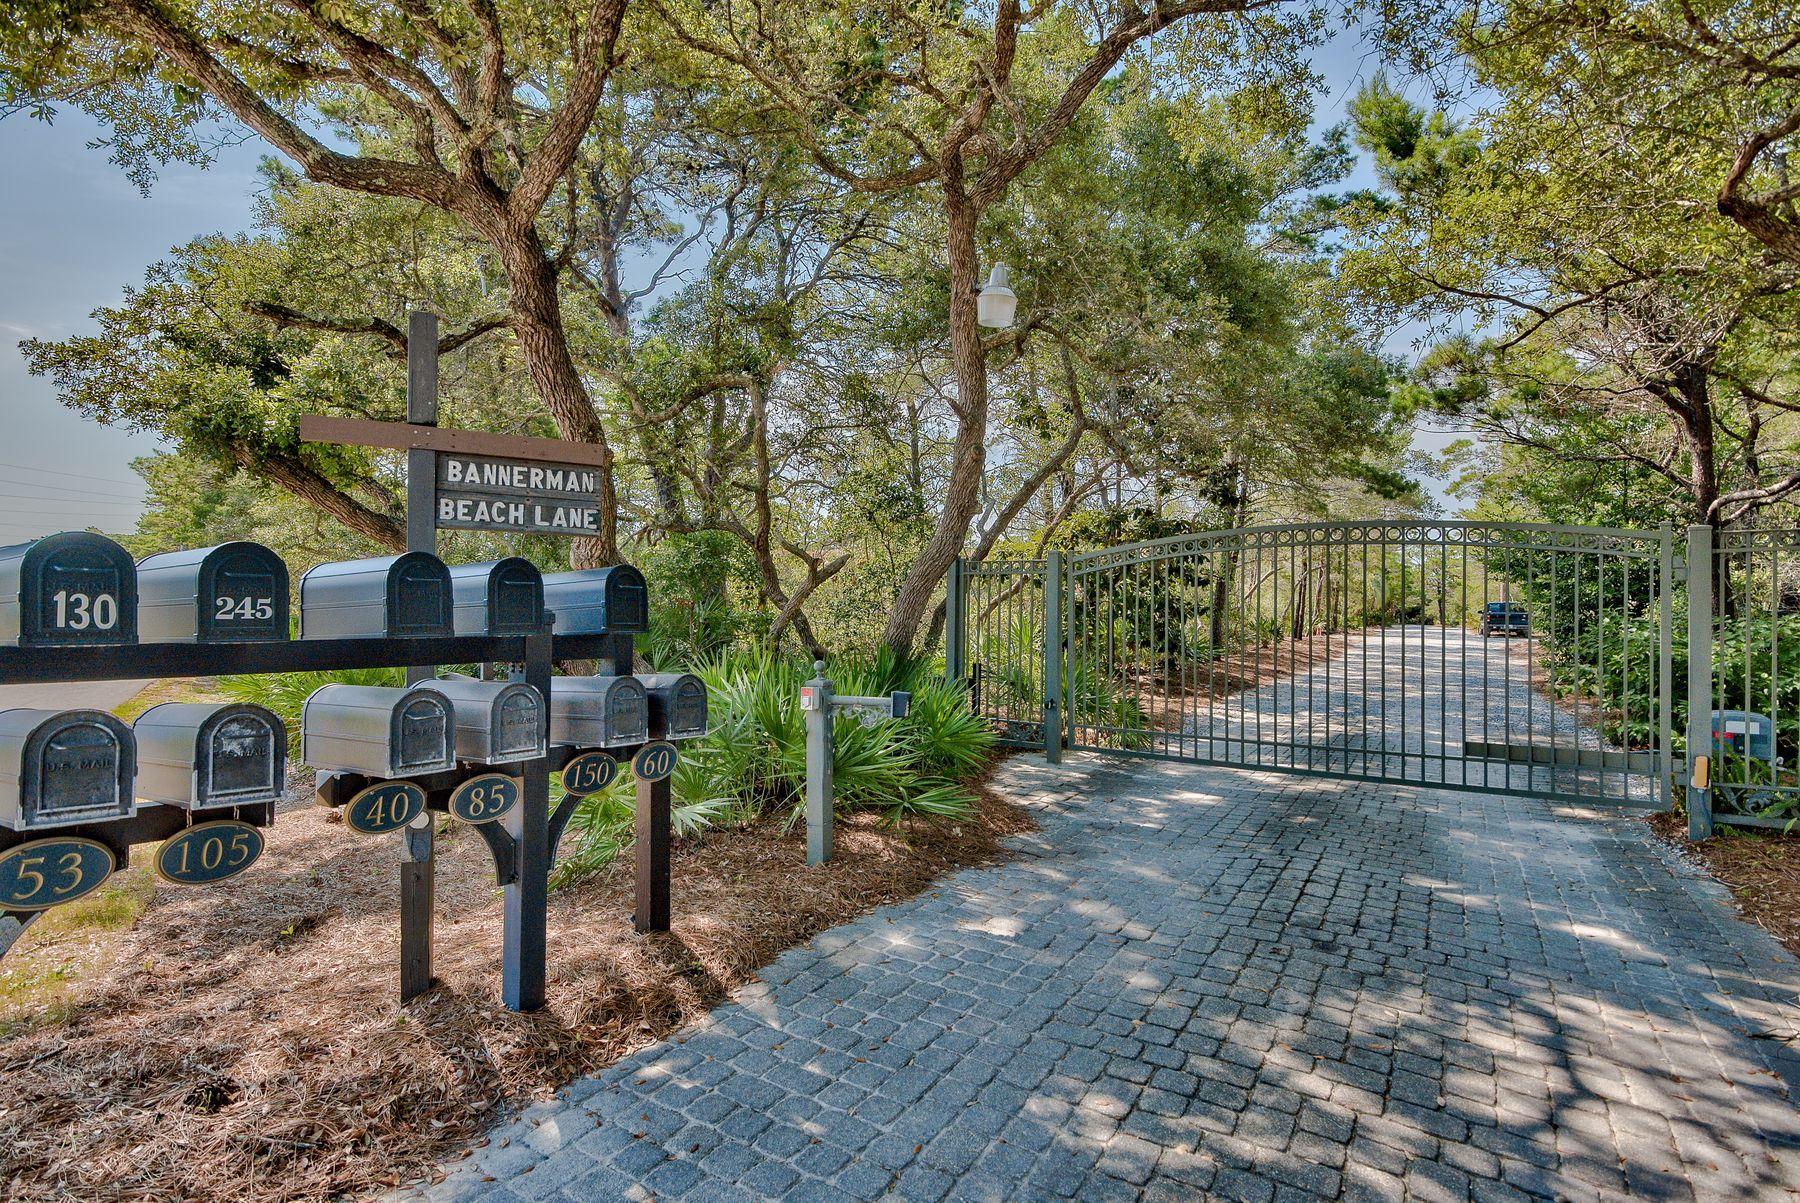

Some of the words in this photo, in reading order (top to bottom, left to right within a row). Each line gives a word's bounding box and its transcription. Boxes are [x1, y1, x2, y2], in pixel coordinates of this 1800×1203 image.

[447, 460, 594, 493] BANNERMAN
[439, 498, 525, 526] BEACH
[534, 505, 599, 530] LANE
[53, 590, 117, 630] 130
[215, 596, 273, 620] 245
[573, 761, 610, 789] 150
[643, 750, 670, 774] 60
[365, 791, 409, 828] 40
[469, 784, 505, 817] 85
[175, 834, 250, 875] 105
[13, 853, 83, 900] 53
